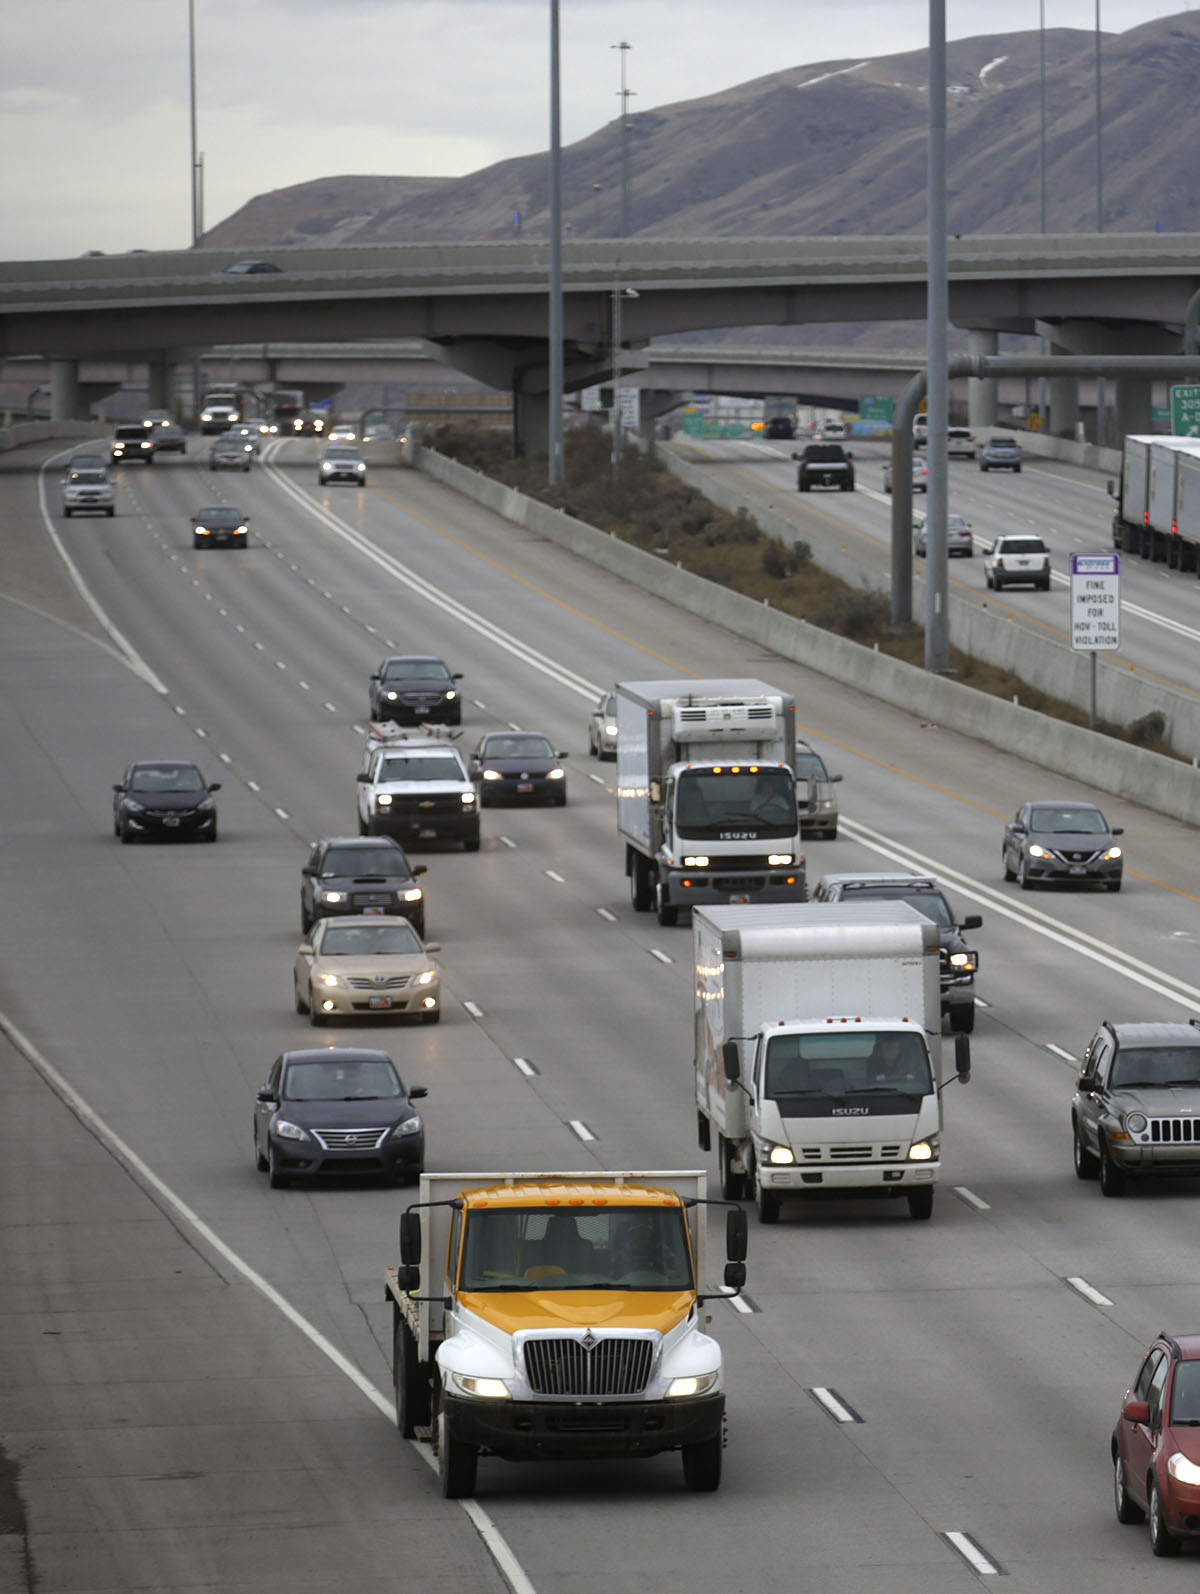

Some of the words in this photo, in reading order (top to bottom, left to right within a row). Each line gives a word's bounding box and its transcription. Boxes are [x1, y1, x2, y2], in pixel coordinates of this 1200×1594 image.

[1086, 581, 1105, 590] FINE
[1076, 594, 1115, 604] IMPOSED
[1087, 608, 1104, 617] FOR
[1075, 636, 1117, 645] VIOLATION
[720, 832, 757, 840] ISUZU
[832, 1107, 869, 1116] ISUZU
